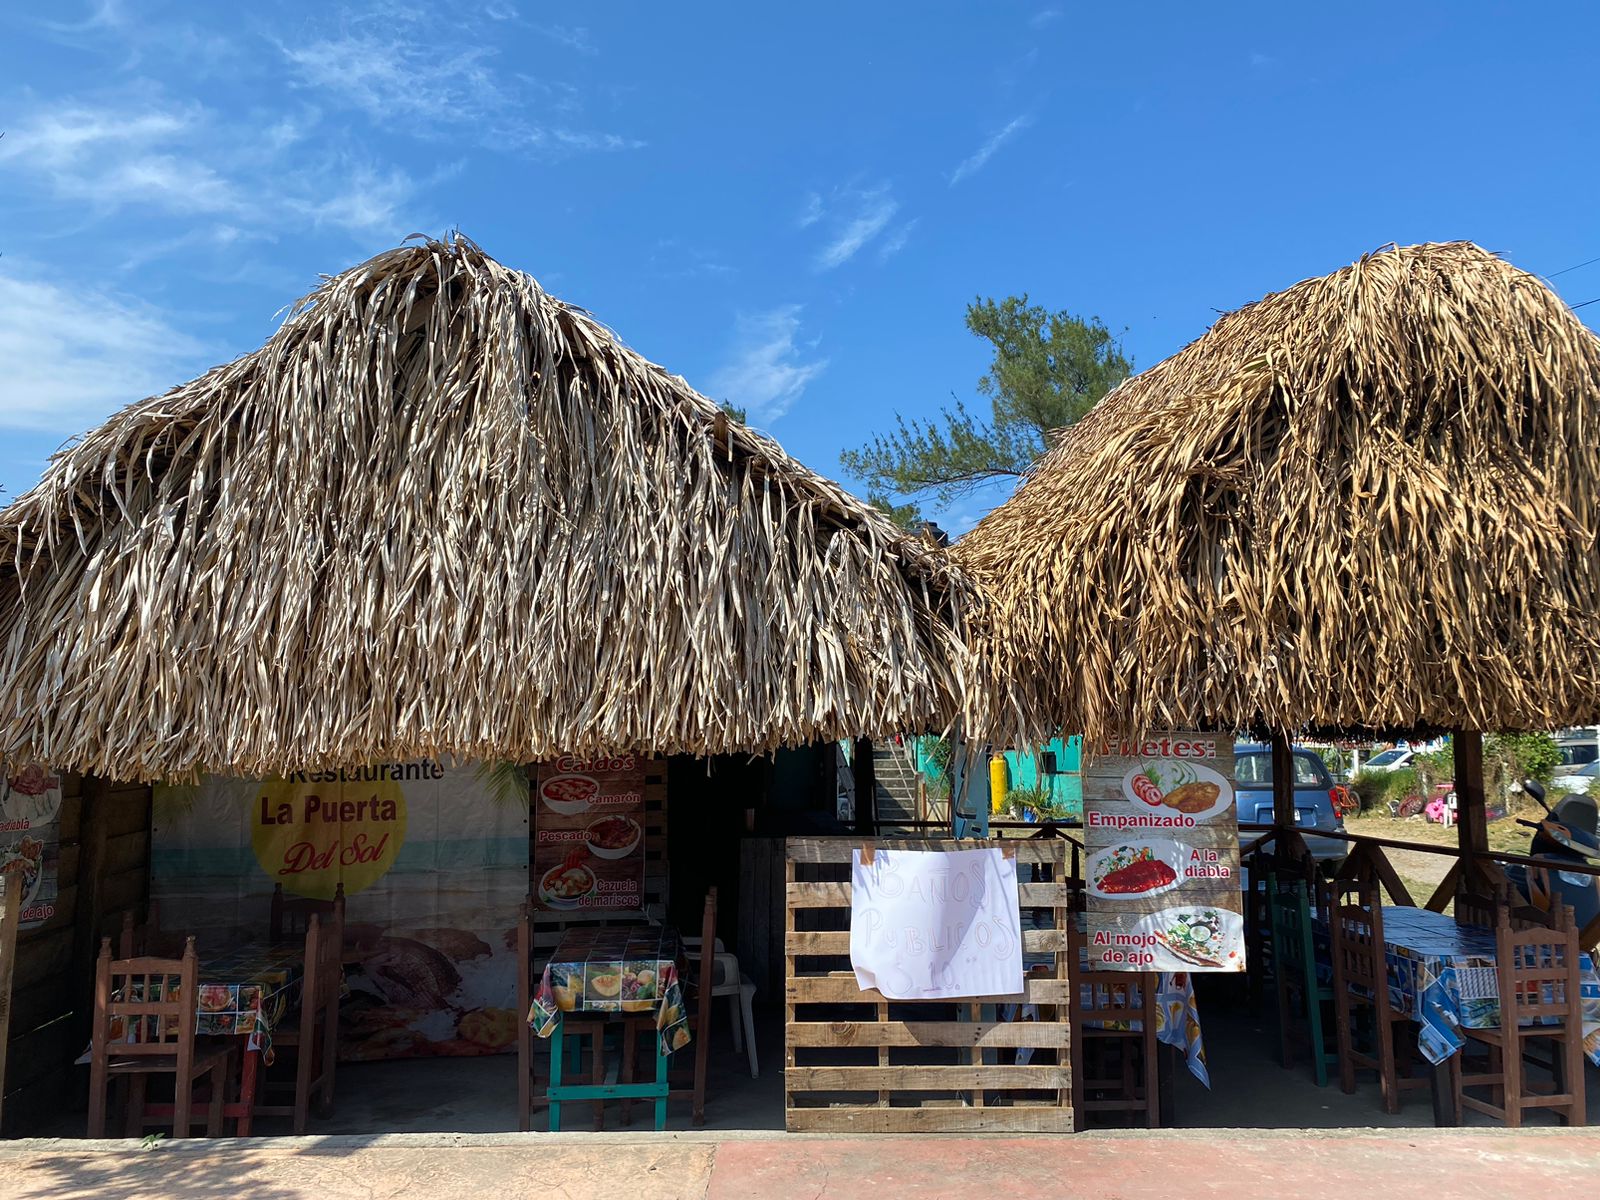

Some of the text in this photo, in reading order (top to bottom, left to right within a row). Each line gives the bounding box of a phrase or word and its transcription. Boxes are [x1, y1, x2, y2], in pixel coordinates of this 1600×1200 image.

[289, 758, 445, 784] Restaurante
[556, 755, 635, 773] Caldos
[586, 791, 640, 805] Camarón
[261, 794, 397, 825] La Puerta
[1089, 812, 1196, 830] Empanizado
[539, 830, 593, 842] Pescado
[278, 833, 389, 875] Del Sol
[1190, 849, 1217, 862] A la
[1185, 865, 1230, 878] diabla
[596, 879, 637, 892] Cazuela
[578, 894, 640, 906] de mariscos
[22, 905, 53, 920] de ajo
[1094, 931, 1157, 948] Al mojo
[1103, 950, 1154, 966] de ajo
